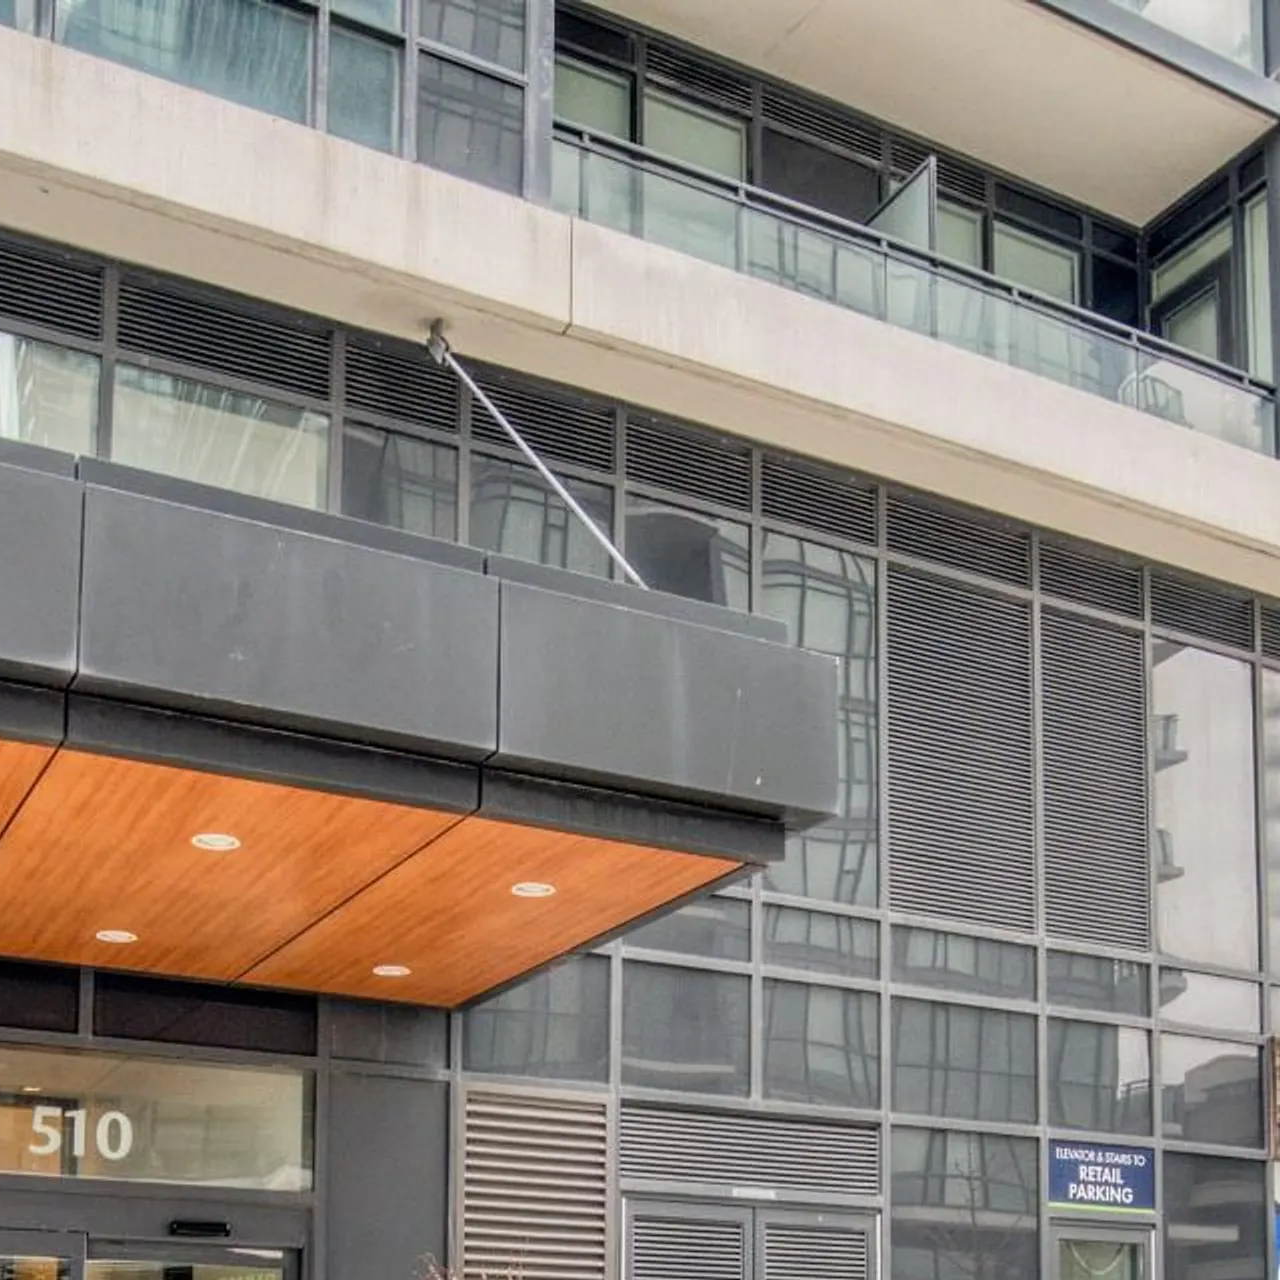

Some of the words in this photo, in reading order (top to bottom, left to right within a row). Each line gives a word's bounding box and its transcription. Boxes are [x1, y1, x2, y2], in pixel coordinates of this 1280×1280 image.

[28, 1105, 134, 1160] 510
[1055, 1146, 1096, 1162] ELEVATOR
[1097, 1151, 1104, 1162] &
[1106, 1151, 1132, 1166] STAIRS
[1133, 1154, 1146, 1167] TO
[1079, 1164, 1125, 1185] RETAIL
[1068, 1183, 1134, 1204] PARKING
